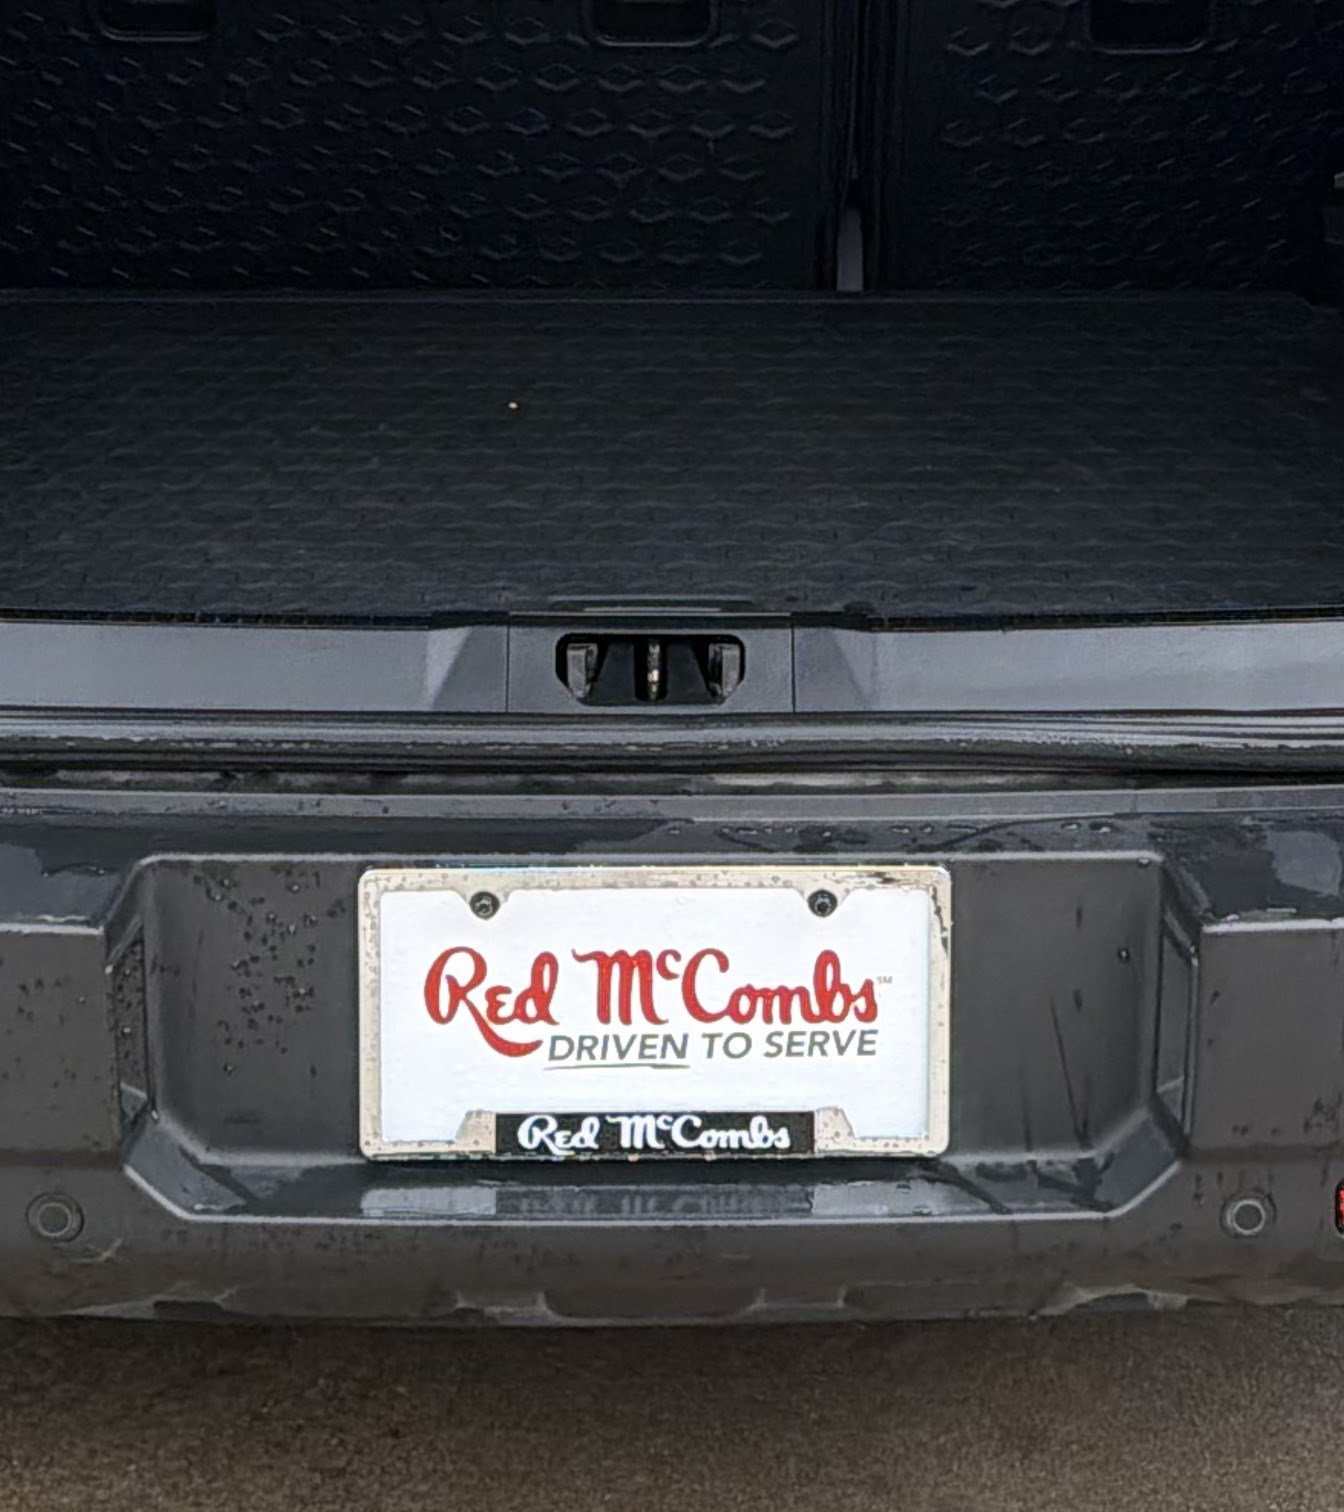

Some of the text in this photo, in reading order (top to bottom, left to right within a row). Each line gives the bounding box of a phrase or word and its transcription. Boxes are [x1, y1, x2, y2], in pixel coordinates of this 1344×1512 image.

[423, 946, 560, 1057] Red
[571, 947, 879, 1025] McCombs
[547, 1029, 880, 1062] DRIVEN TO SERVE
[516, 1113, 792, 1155] Red McCombs
